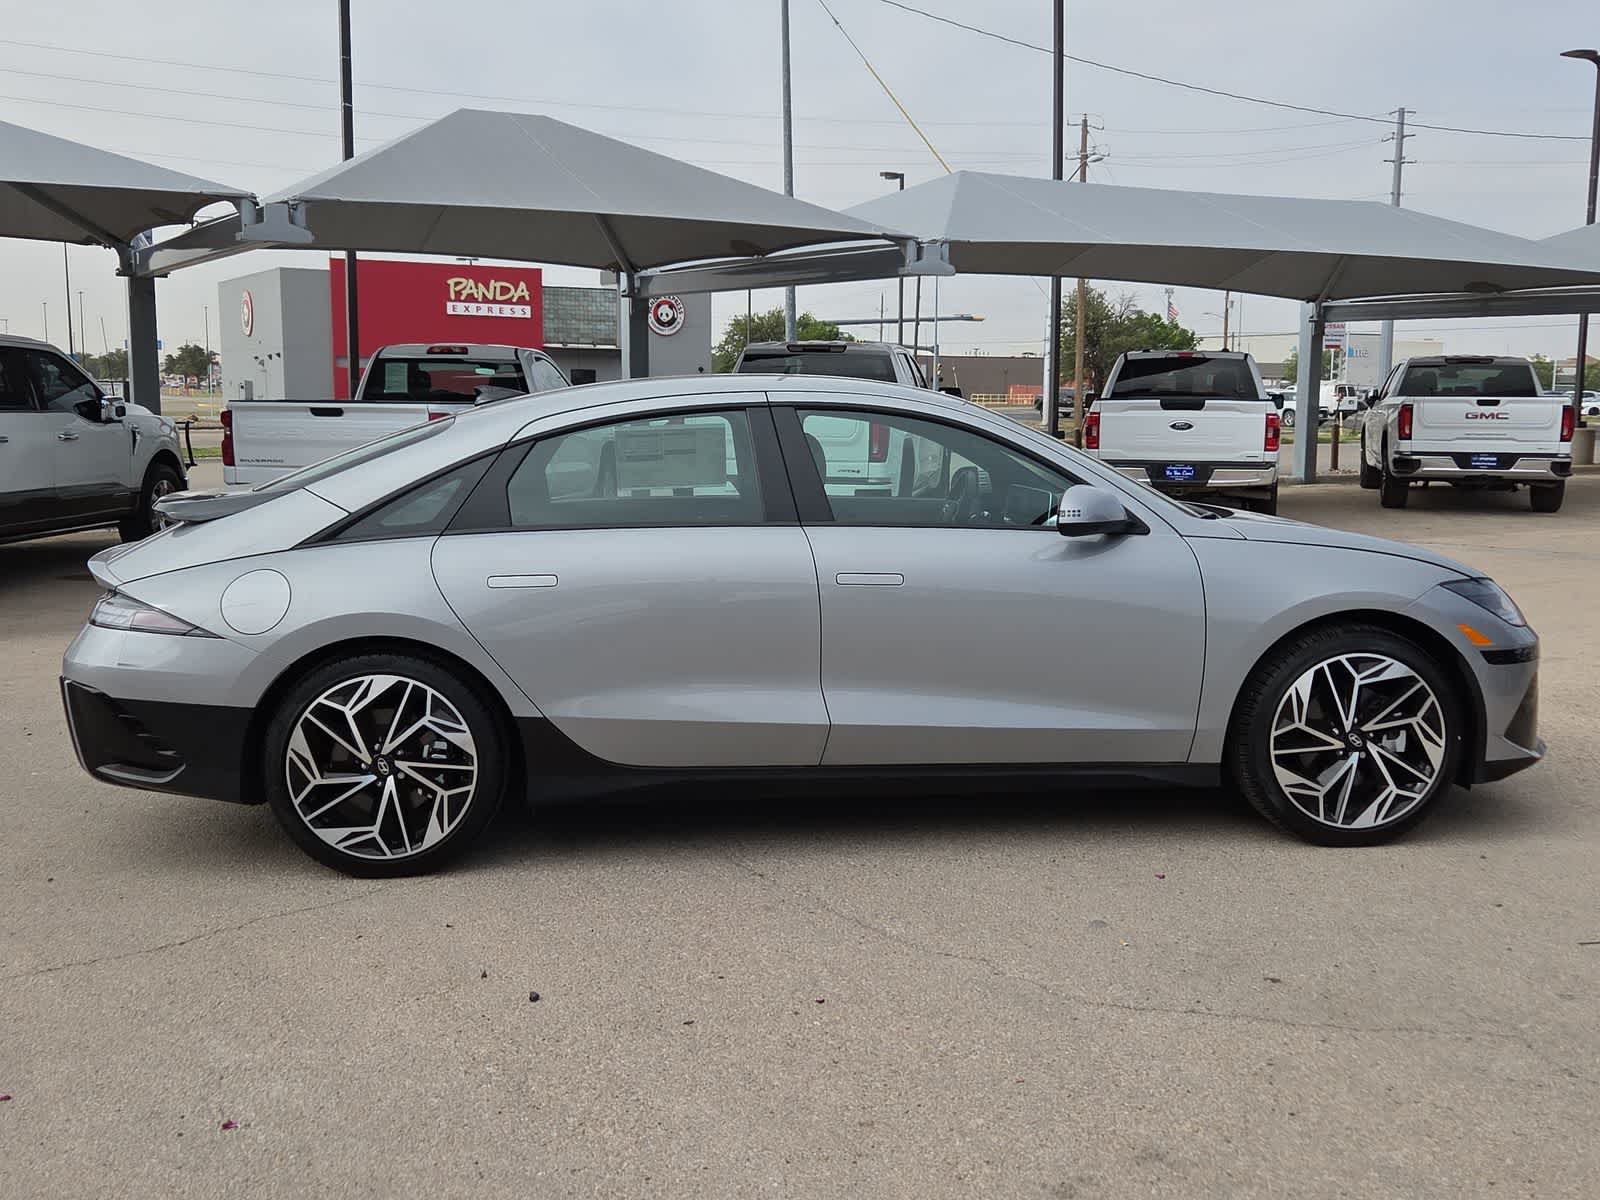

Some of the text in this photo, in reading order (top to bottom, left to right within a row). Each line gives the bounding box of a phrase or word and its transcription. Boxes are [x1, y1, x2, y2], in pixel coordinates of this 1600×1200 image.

[447, 277, 530, 302] PANDA
[452, 304, 527, 315] EXPRESS
[1465, 412, 1510, 420] GMC
